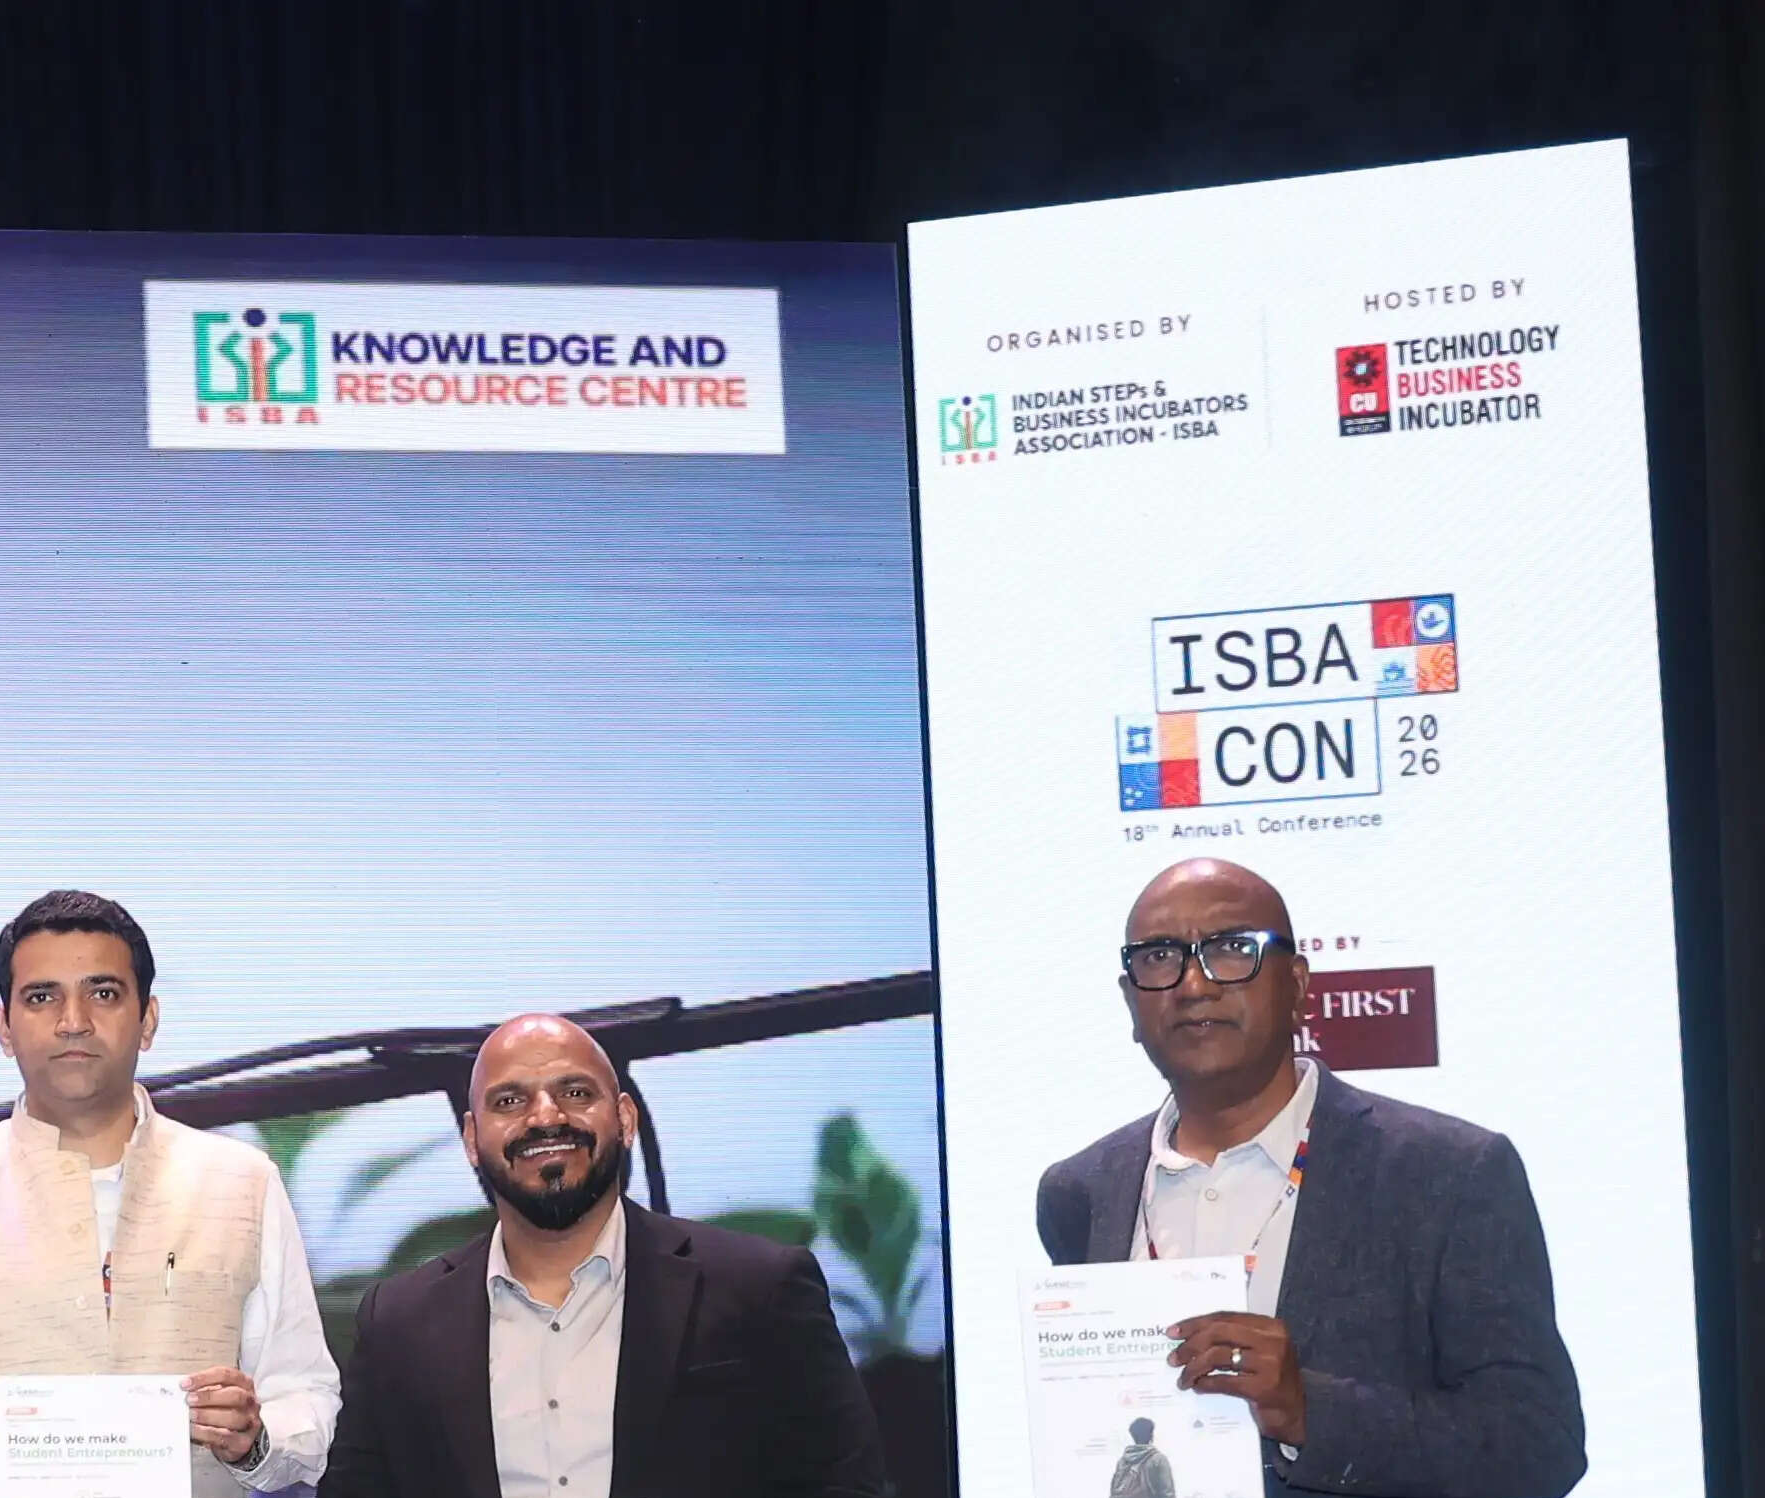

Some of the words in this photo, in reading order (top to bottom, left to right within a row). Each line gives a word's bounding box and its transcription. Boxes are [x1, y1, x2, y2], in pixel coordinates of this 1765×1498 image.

[1364, 284, 1477, 313] HOSTED
[1492, 278, 1525, 299] BY
[332, 332, 617, 367] KNOWLEDGE
[629, 334, 727, 367] AND
[987, 319, 1145, 353] ORGANISED
[1160, 314, 1192, 335] BY
[1393, 324, 1560, 367] TECHNOLOGY
[335, 373, 567, 408] RESOURCE
[578, 375, 748, 409] CENTRE
[1012, 388, 1084, 411] INDIAN
[1090, 382, 1148, 403] STEPs
[1155, 380, 1167, 397] &
[1396, 361, 1523, 398] BUSINESS
[1013, 406, 1110, 433] BUSINESS
[1116, 394, 1248, 422] INCUBATORS
[1398, 393, 1541, 431] INCUBATOR
[1014, 426, 1155, 456] ASSOCIATION
[1174, 420, 1219, 440] ISBA
[1169, 622, 1358, 695] ISBA
[1397, 714, 1439, 743] 20
[1215, 718, 1355, 787] CON
[1399, 748, 1441, 777] 26
[1171, 819, 1244, 840] Annual
[1258, 812, 1383, 835] Conference
[1336, 936, 1361, 950] BY
[1322, 987, 1416, 1019] FIRST
[1038, 1331, 1074, 1344] How
[1079, 1328, 1098, 1341] do
[1103, 1329, 1126, 1339] we
[1131, 1325, 1168, 1338] mak
[1039, 1344, 1102, 1359] Student
[8, 1434, 38, 1445] How
[43, 1433, 60, 1445] do
[65, 1435, 85, 1444] we
[89, 1433, 127, 1444] make
[8, 1446, 62, 1459] Student
